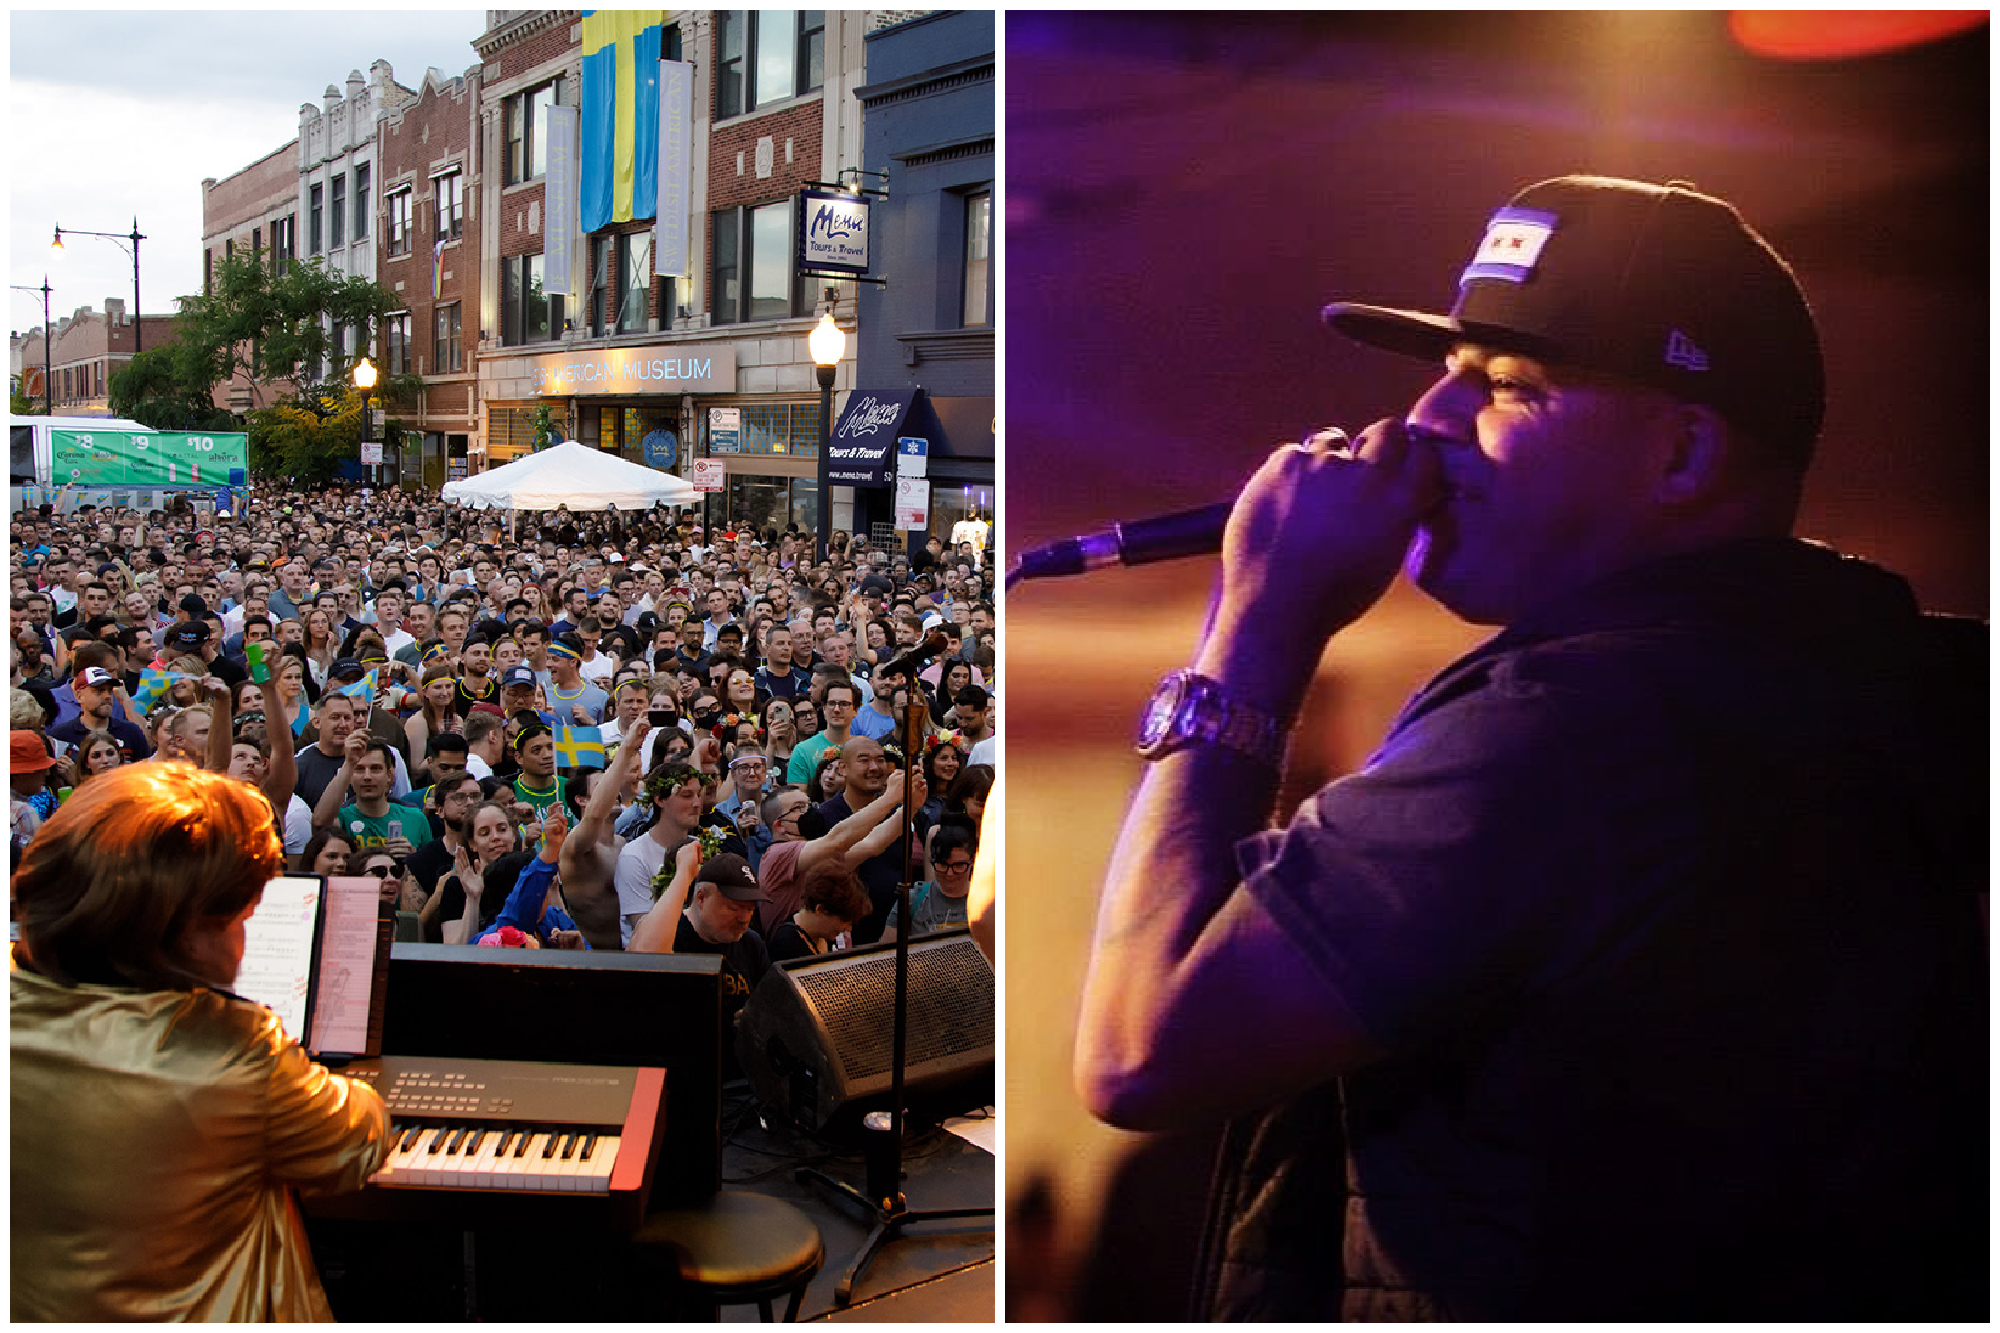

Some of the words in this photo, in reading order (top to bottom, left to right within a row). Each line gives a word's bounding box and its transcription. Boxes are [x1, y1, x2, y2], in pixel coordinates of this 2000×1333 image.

[667, 70, 682, 175] AMERICAN
[551, 145, 568, 255] MUSEUM
[553, 362, 615, 385] AMERICAN
[624, 358, 711, 380] MUSEUM
[130, 435, 149, 450] $9
[187, 436, 214, 452] $10
